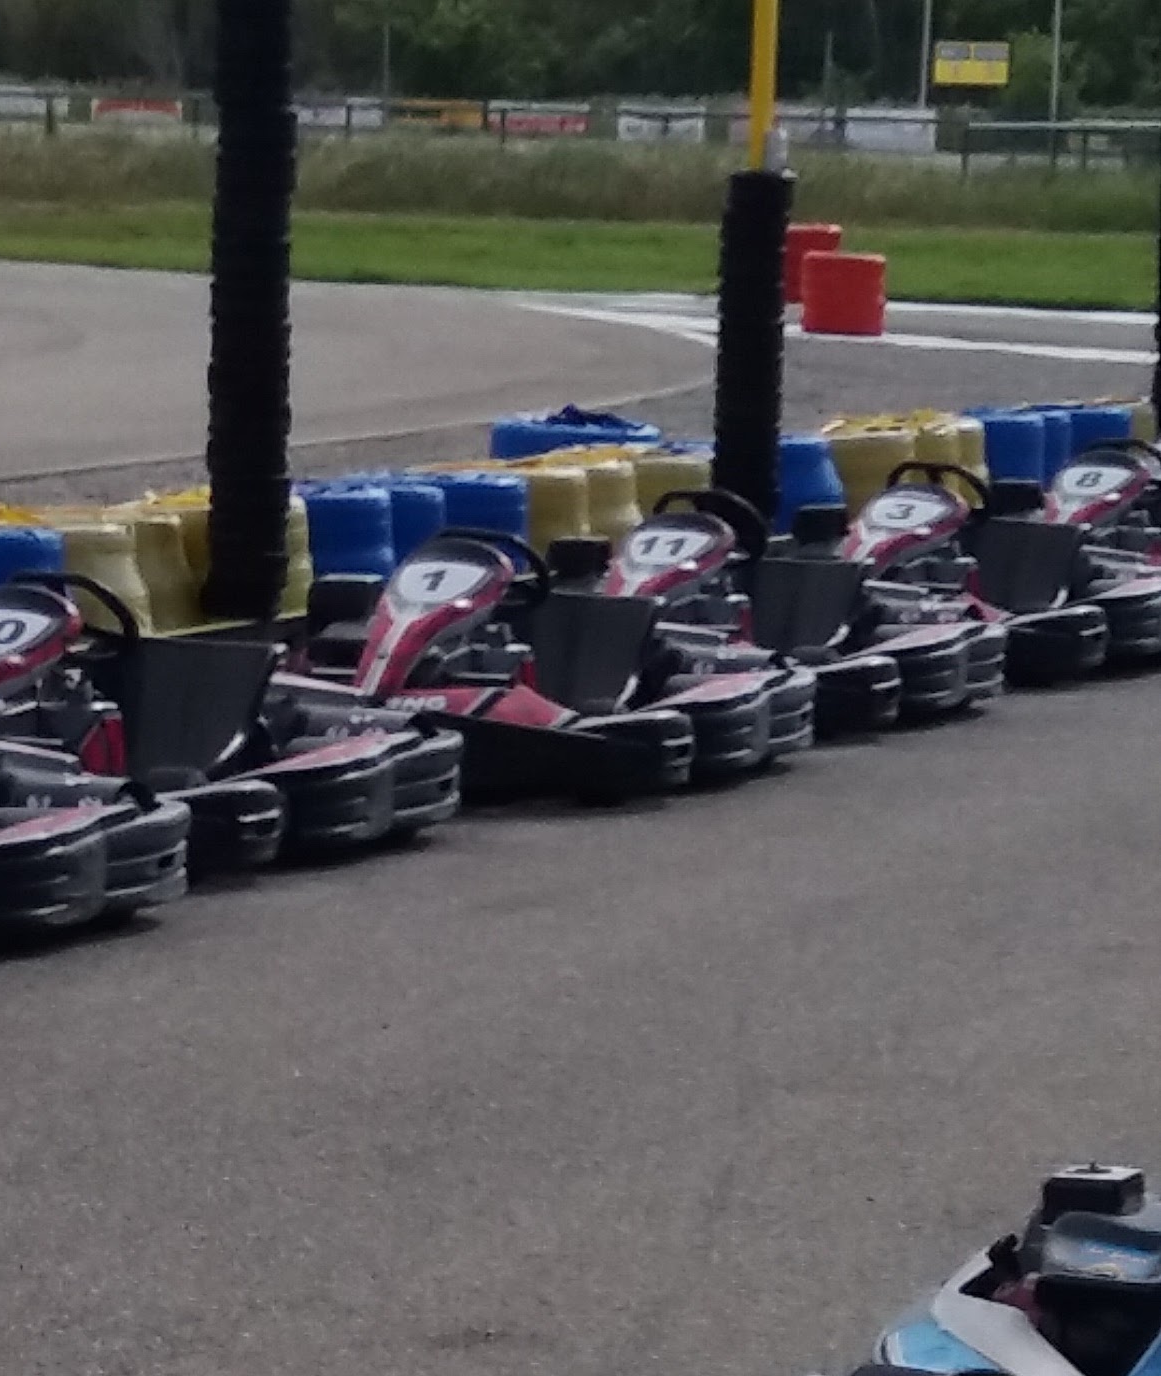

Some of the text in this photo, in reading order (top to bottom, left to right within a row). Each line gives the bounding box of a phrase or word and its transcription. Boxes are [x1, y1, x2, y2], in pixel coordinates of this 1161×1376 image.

[886, 504, 914, 521] 3
[641, 537, 686, 556] 11
[423, 570, 448, 591] 1
